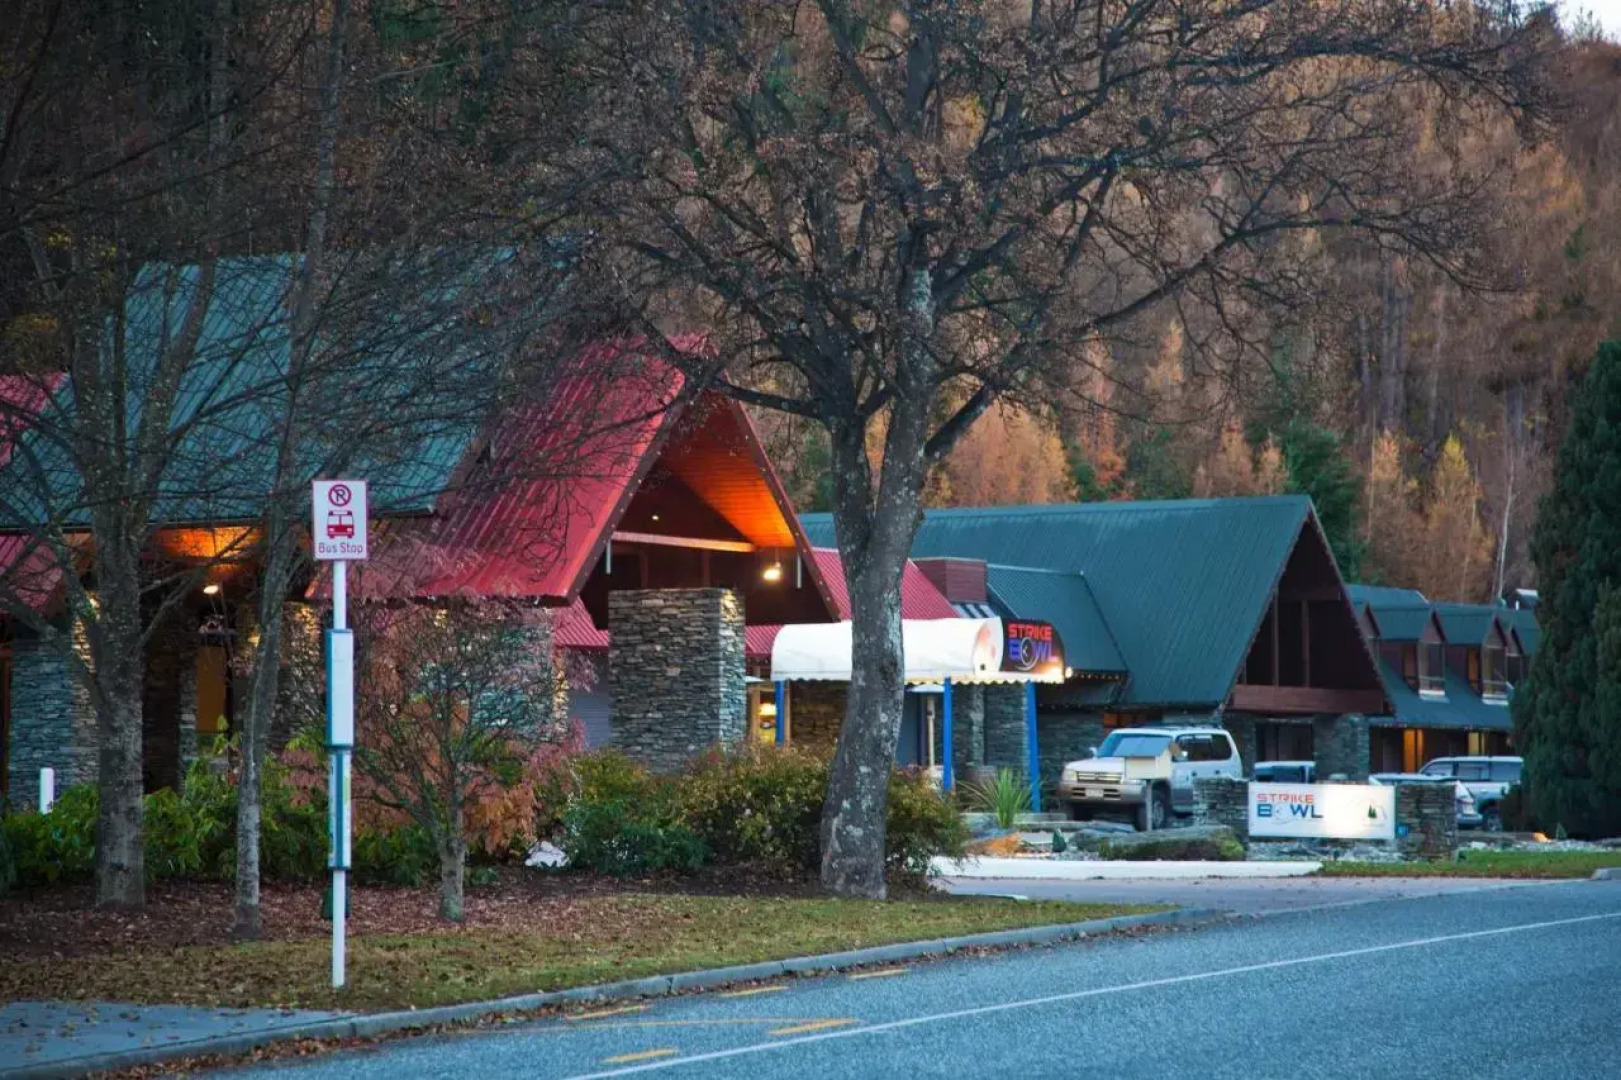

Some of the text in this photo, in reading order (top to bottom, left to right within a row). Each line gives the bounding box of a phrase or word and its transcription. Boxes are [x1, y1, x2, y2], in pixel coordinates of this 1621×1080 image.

[319, 542, 363, 554] Bus Stop
[1008, 623, 1052, 640] STRIKE
[1008, 637, 1058, 667] BOWL
[1256, 793, 1315, 804] STRIKE
